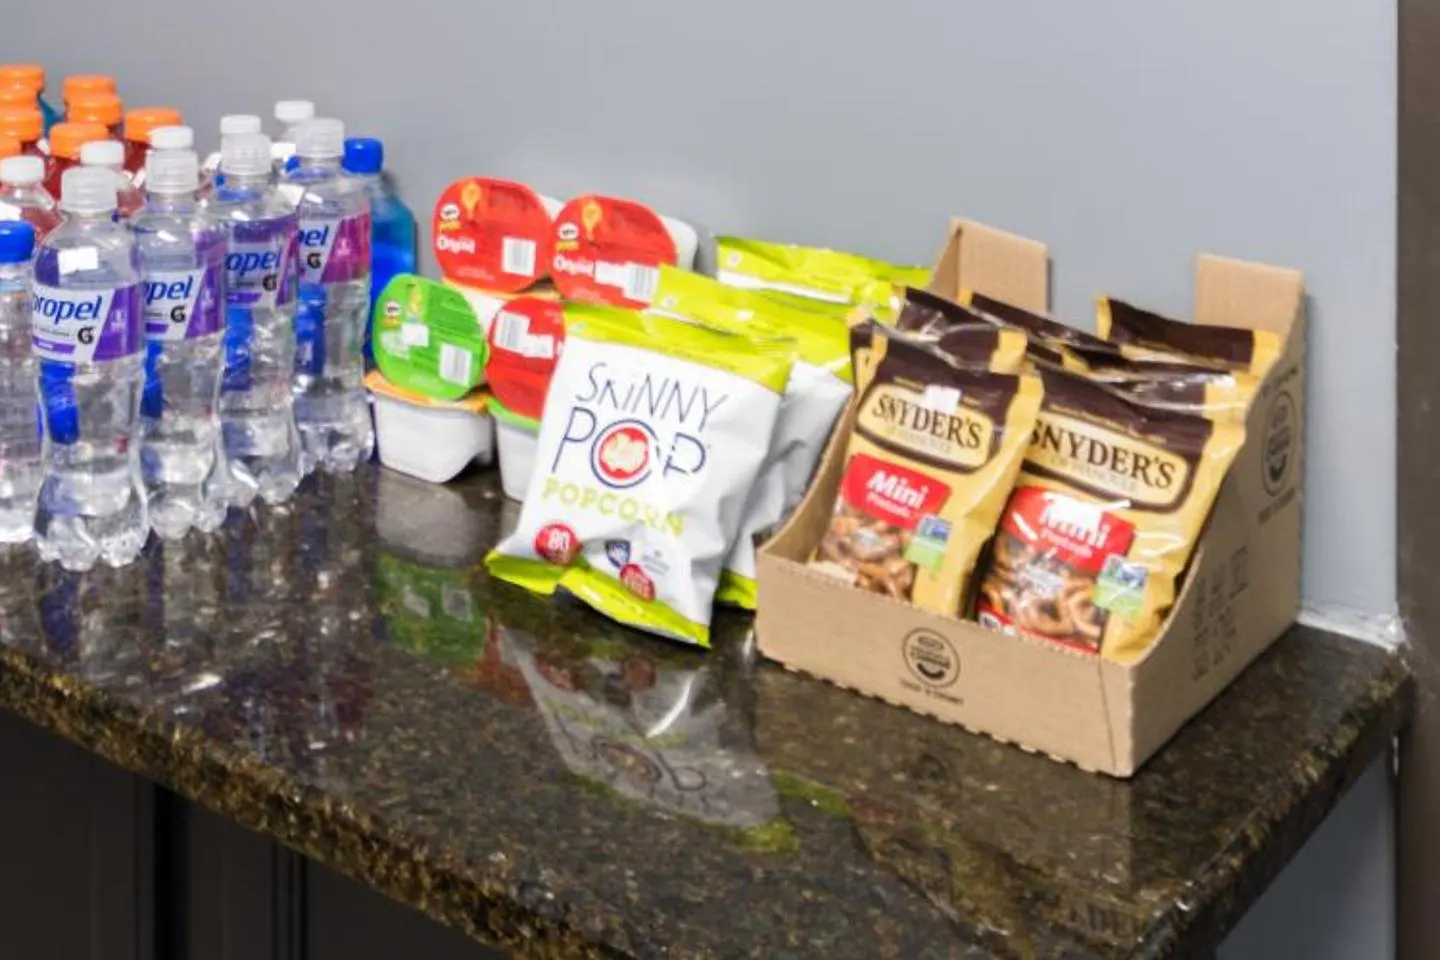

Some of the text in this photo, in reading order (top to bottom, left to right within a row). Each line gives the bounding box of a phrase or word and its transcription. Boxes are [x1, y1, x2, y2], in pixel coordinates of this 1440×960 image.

[551, 406, 707, 490] POP
[871, 393, 983, 450] SNYDER'S
[865, 469, 929, 510] Mini
